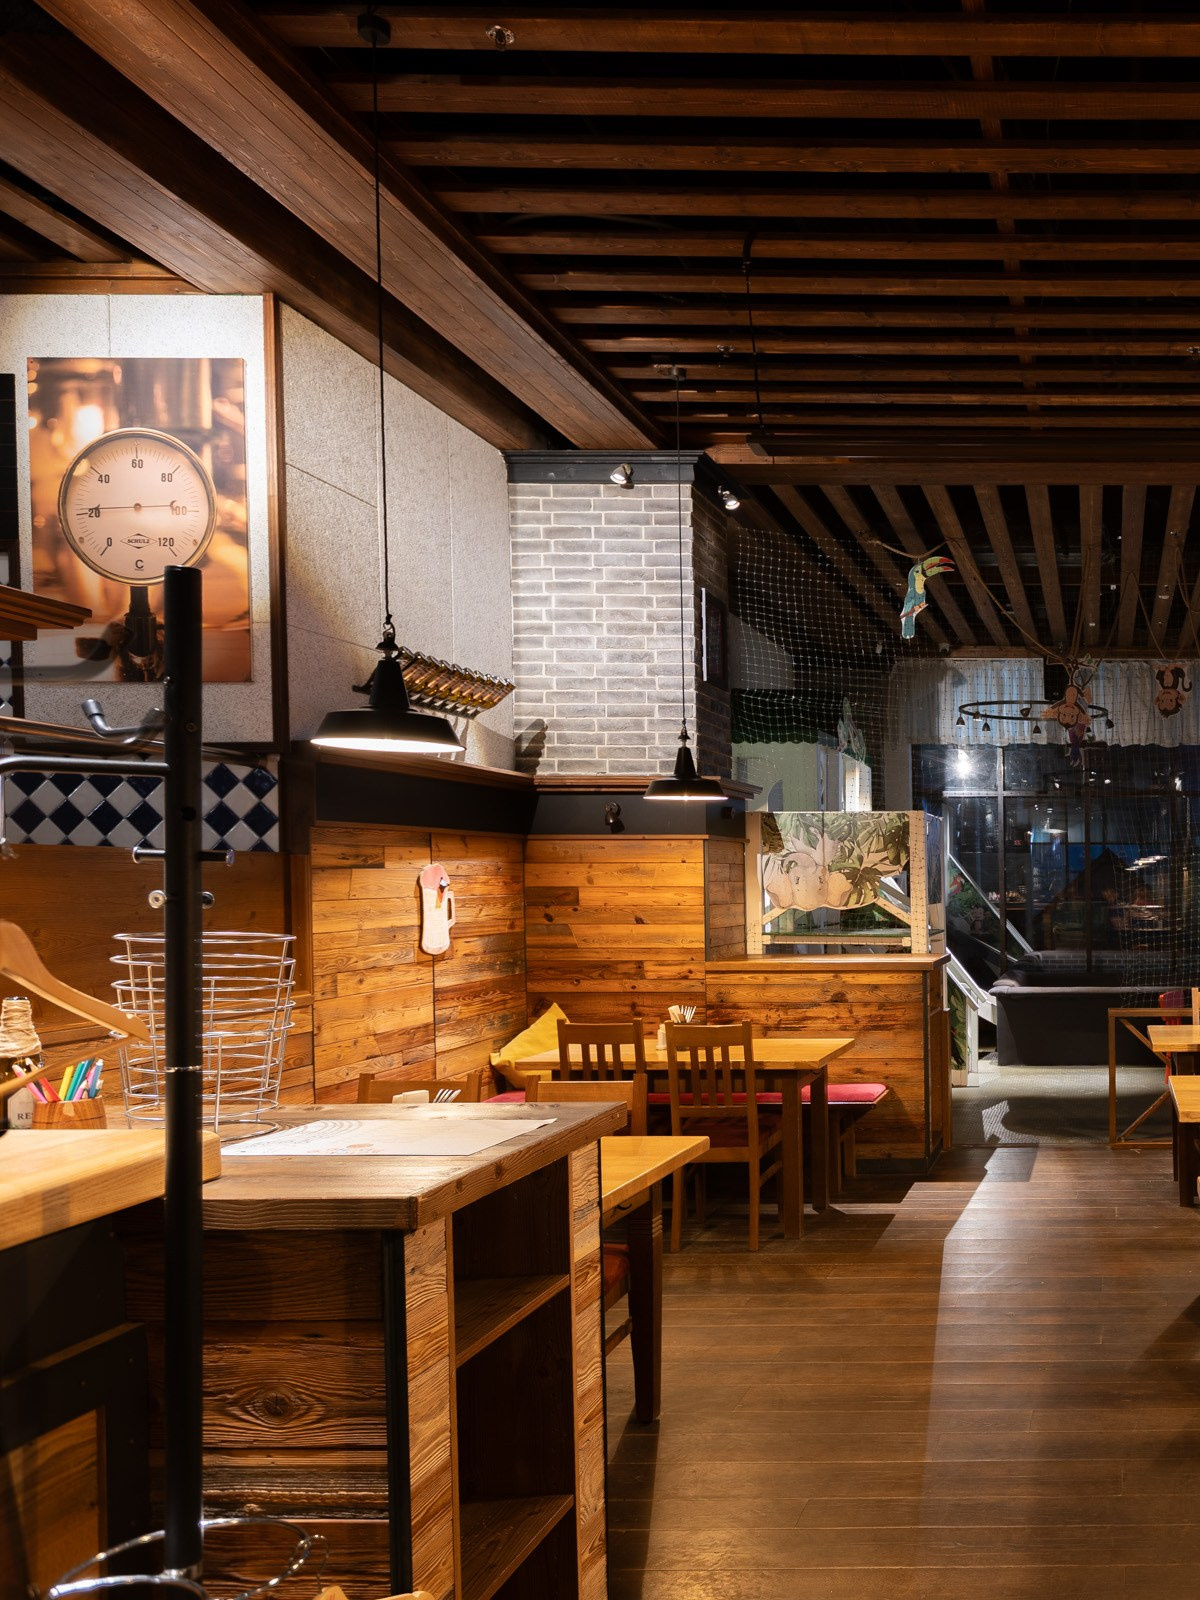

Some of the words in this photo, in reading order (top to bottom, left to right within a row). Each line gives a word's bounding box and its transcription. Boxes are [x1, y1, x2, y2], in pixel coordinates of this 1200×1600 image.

[131, 458, 144, 468] 60
[98, 474, 110, 484] 40
[161, 473, 173, 483] 80
[88, 509, 100, 518] 20
[106, 537, 112, 547] 0
[158, 538, 174, 546] 120
[135, 560, 144, 568] C
[17, 1112, 33, 1120] RE
